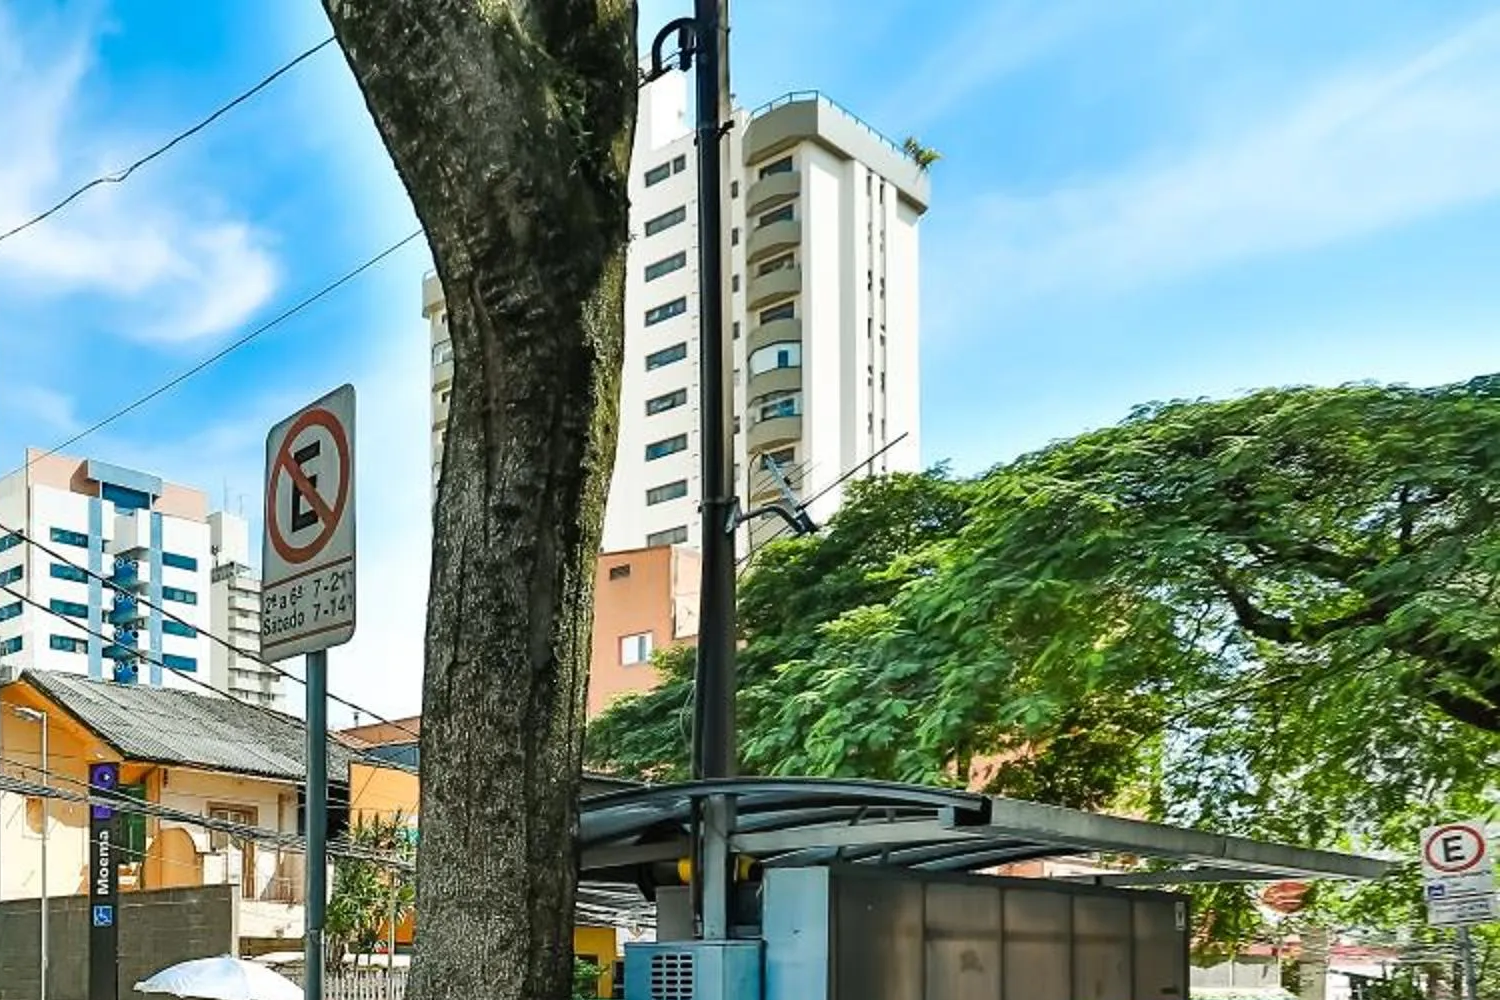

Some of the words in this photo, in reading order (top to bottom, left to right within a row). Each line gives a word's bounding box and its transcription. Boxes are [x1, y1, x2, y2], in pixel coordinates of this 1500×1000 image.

[291, 439, 321, 533] E
[279, 595, 287, 609] a
[97, 830, 110, 896] Moema
[1442, 835, 1465, 862] E
